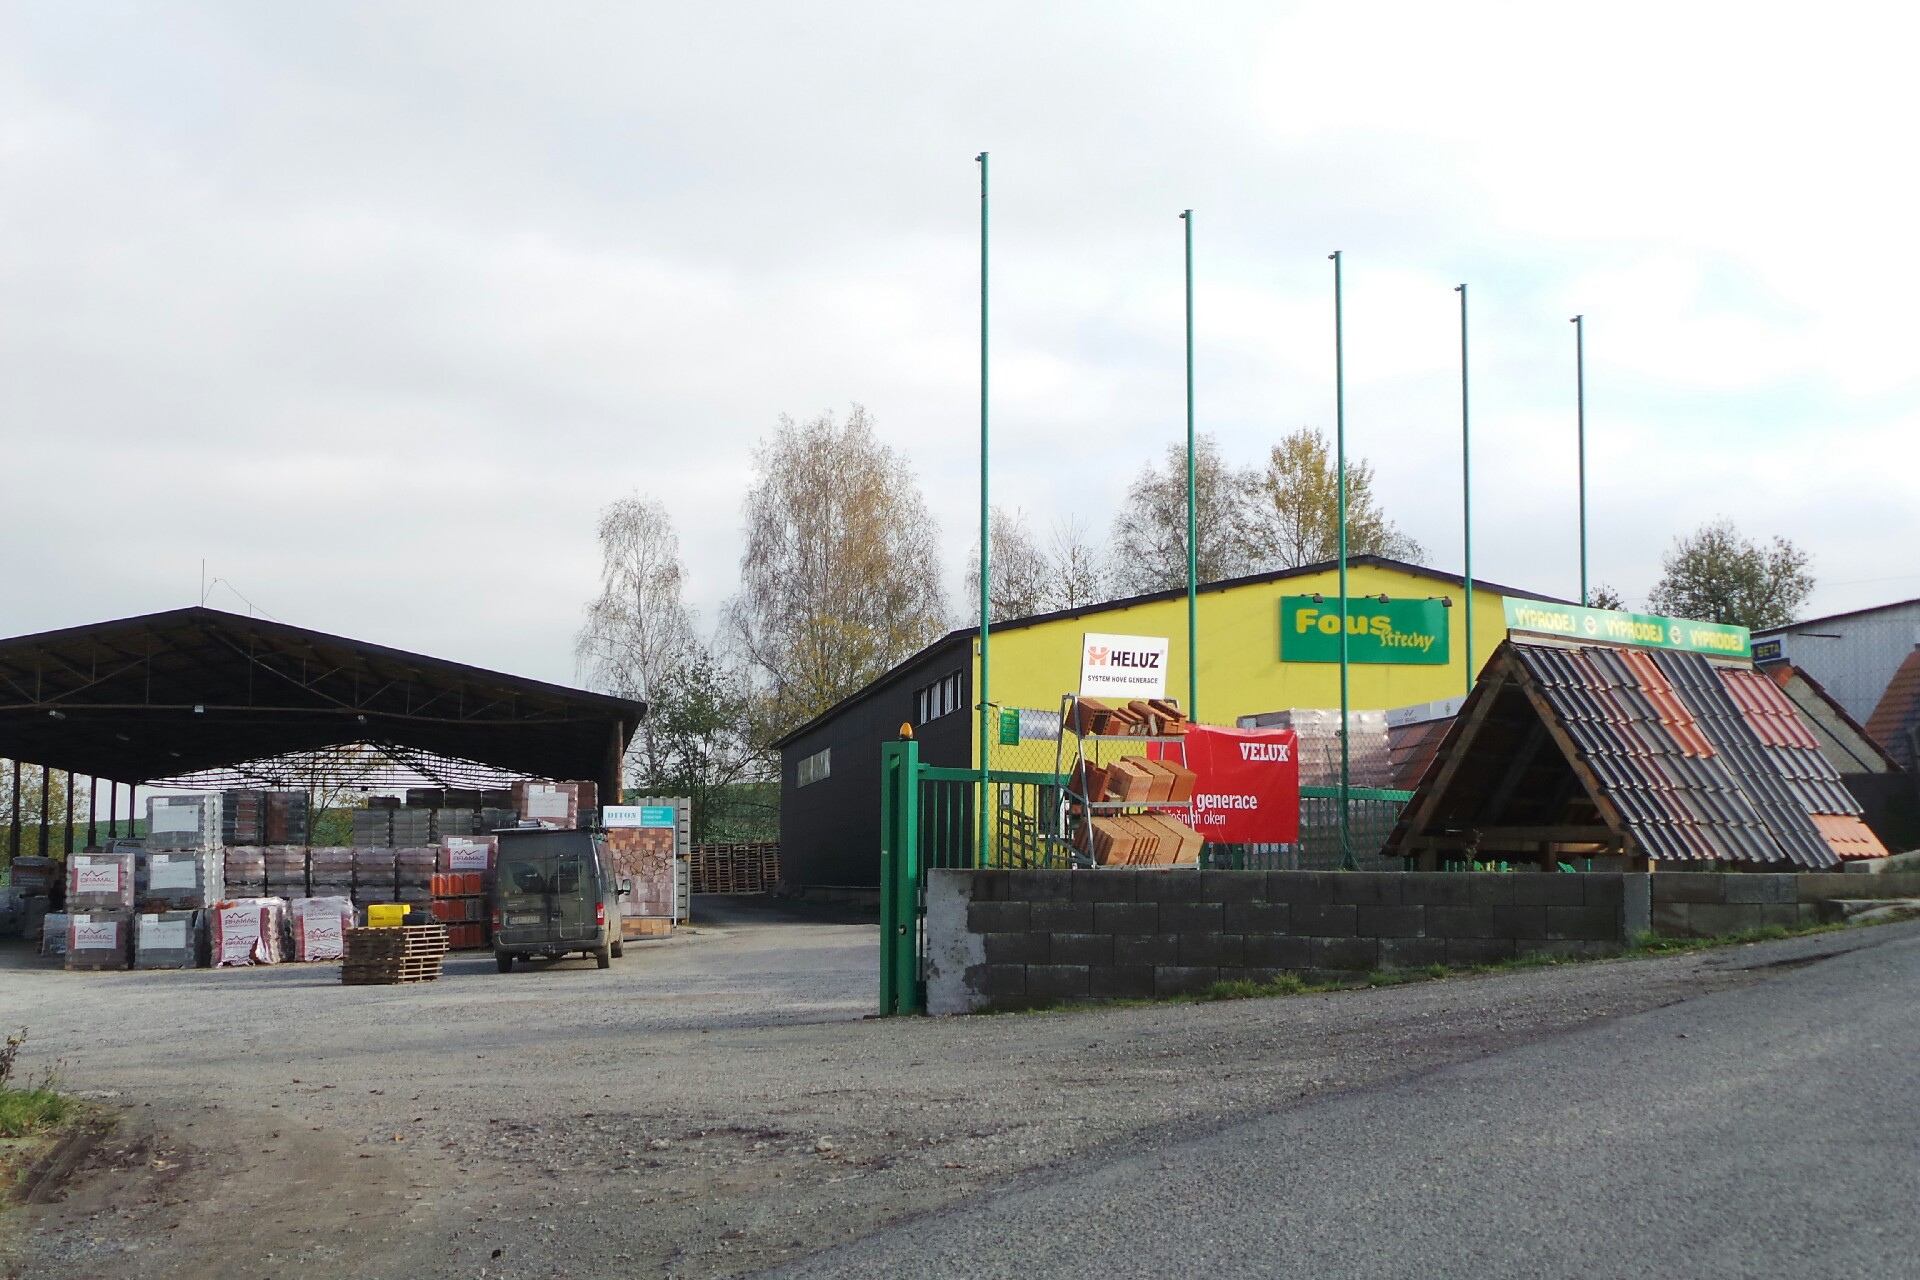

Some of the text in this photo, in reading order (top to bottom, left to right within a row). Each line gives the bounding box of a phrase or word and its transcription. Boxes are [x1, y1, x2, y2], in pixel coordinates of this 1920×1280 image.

[1296, 609, 1392, 635] Fous
[1516, 605, 1745, 652] VÝPRODEJ VÝPRODEJ VÝPRODEJ
[1110, 651, 1160, 668] HELUZ
[1239, 742, 1289, 762] VELUX
[1196, 794, 1258, 812] generace
[1203, 811, 1226, 825] oken
